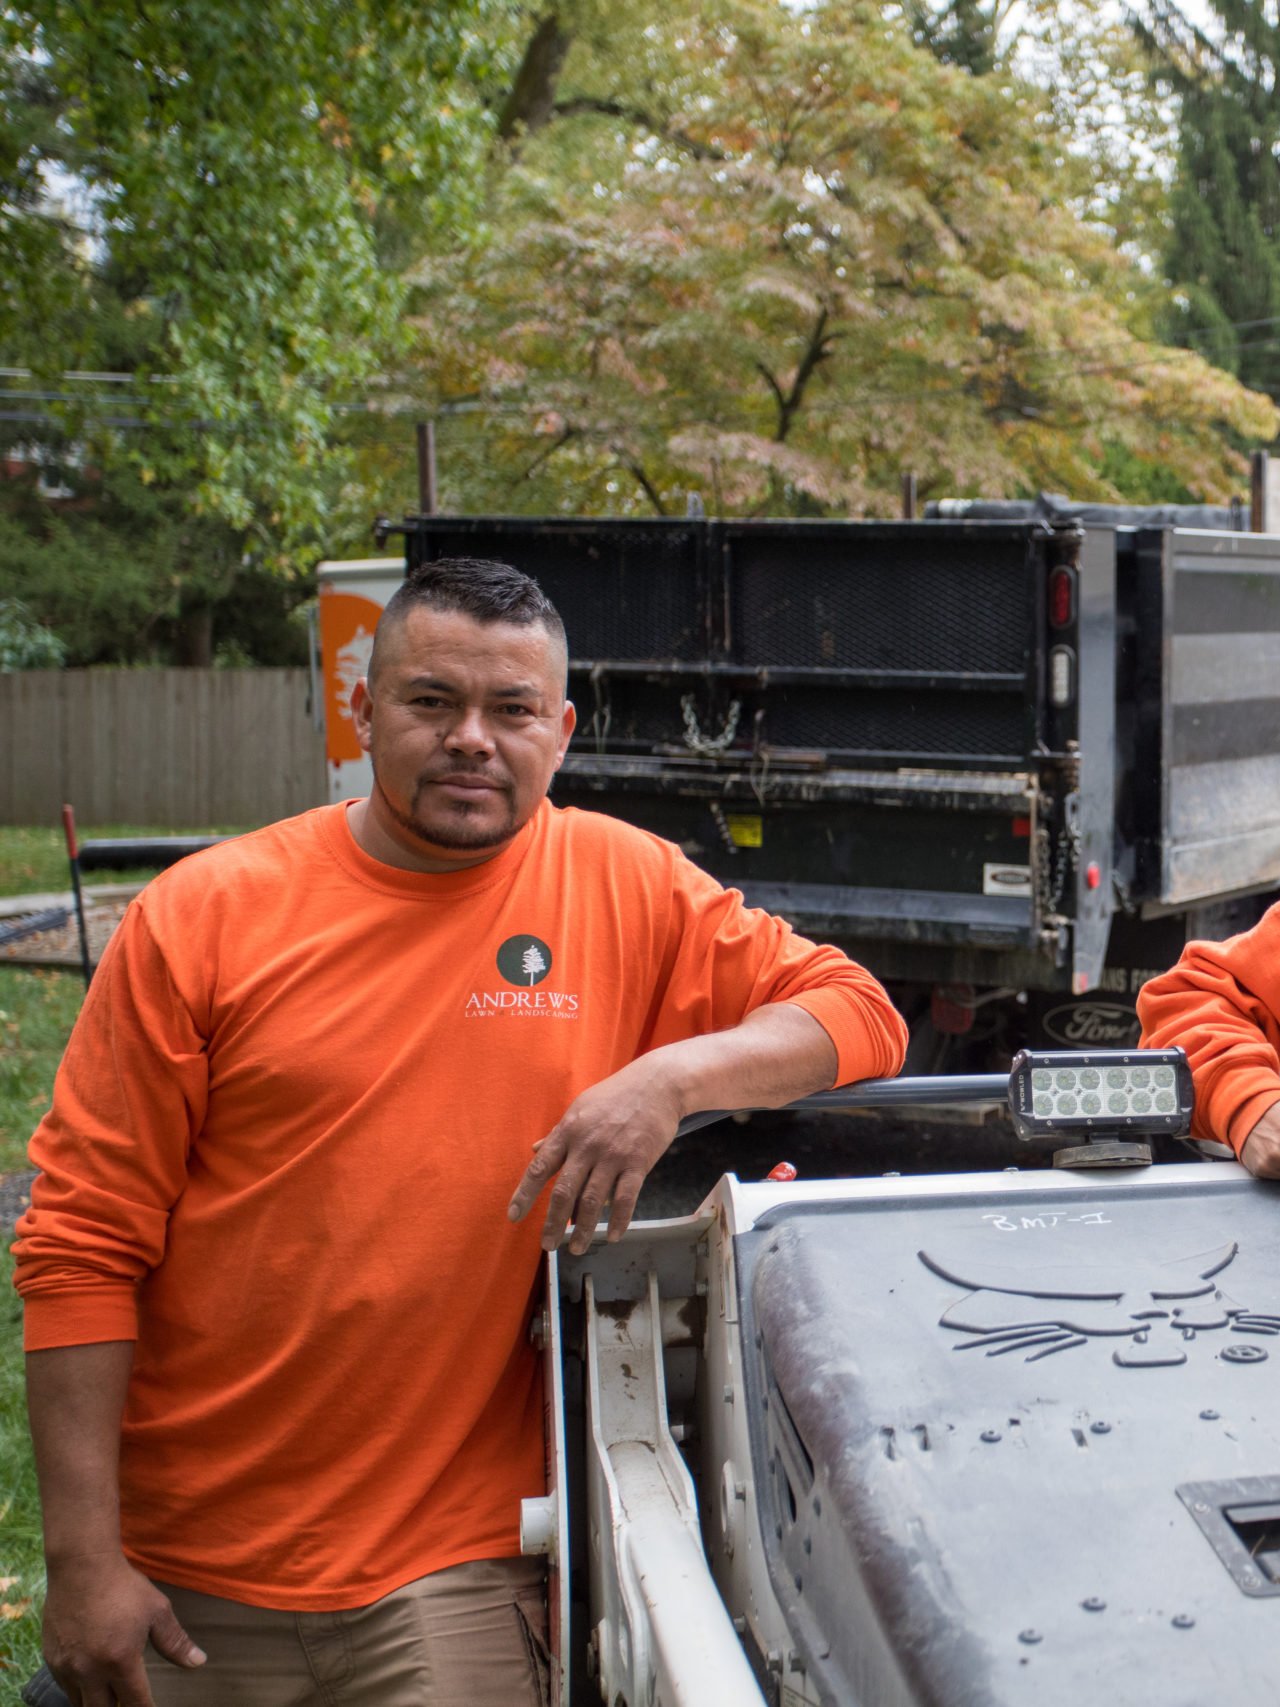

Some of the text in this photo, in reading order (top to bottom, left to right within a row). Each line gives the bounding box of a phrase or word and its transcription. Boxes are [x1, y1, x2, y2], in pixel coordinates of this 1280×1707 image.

[465, 991, 579, 1011] ANDREW'S
[464, 1010, 496, 1018] LAWN
[510, 1009, 579, 1019] LANDSCAPING
